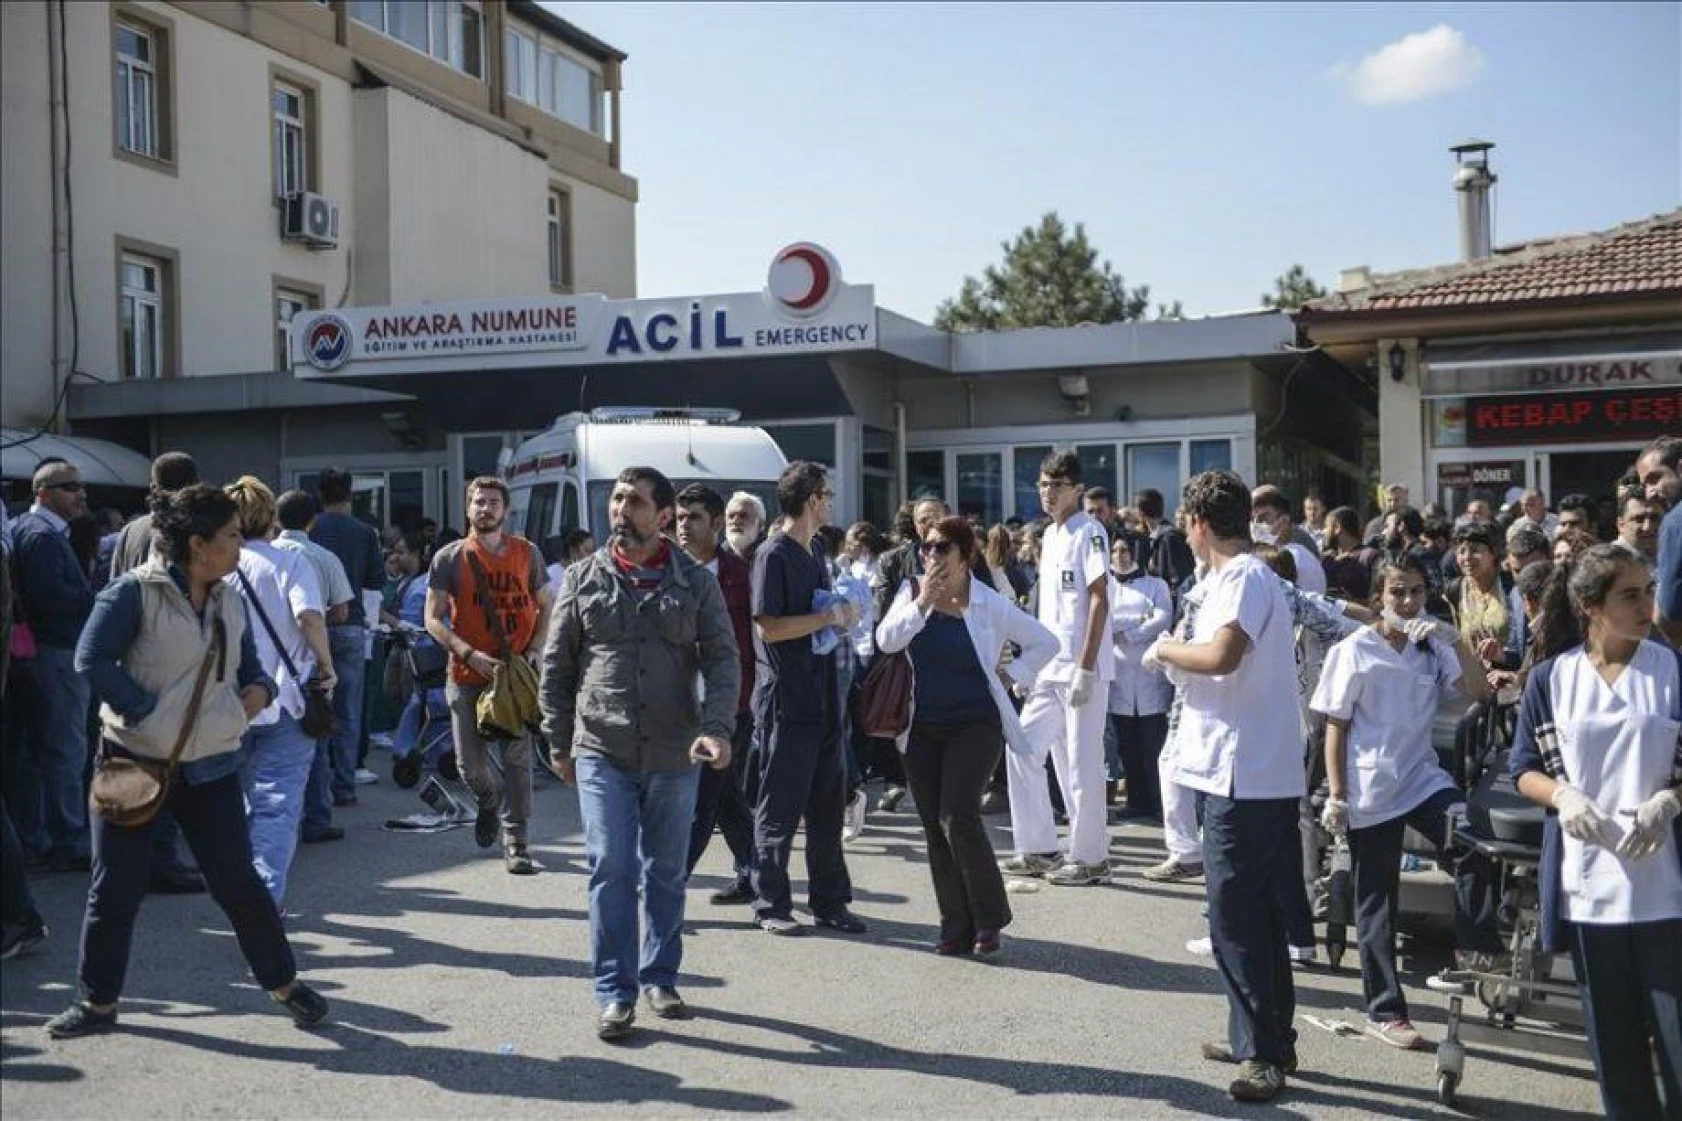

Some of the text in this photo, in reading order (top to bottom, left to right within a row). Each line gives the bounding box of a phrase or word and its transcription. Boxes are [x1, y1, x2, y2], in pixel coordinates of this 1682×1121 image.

[364, 306, 577, 339] ANKARA NUMUNE
[606, 302, 743, 356] ACİL
[755, 324, 869, 347] EMERGENCY
[413, 339, 427, 351] VE
[1528, 360, 1653, 386] DURAK
[1475, 401, 1595, 429] KEBAP
